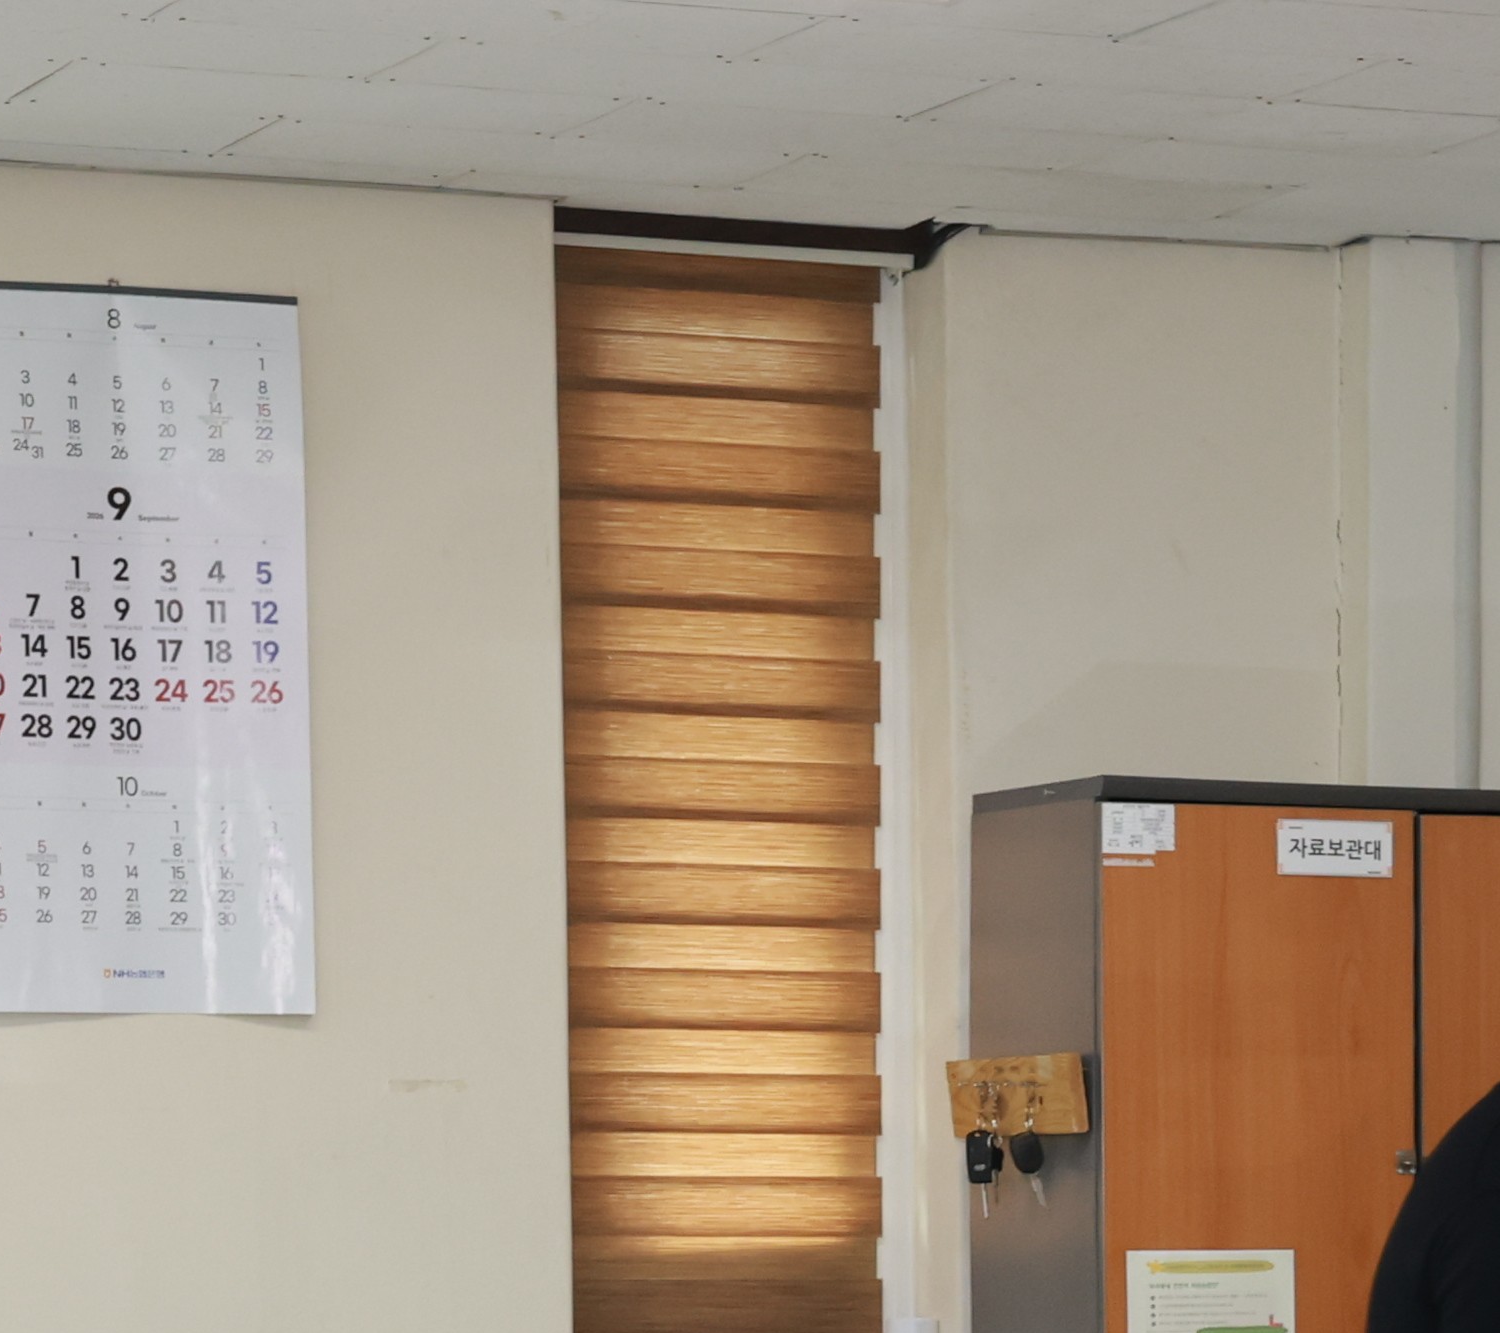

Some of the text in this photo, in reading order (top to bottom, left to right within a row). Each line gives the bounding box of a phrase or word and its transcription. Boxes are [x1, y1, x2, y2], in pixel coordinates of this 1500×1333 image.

[107, 308, 121, 329] 8
[106, 487, 131, 521] 9
[71, 555, 272, 584] 1 2 3 4 5
[25, 593, 40, 616] 7
[70, 595, 85, 619] 8
[114, 597, 129, 621] 9
[154, 599, 183, 623] 10
[205, 599, 225, 623] 11
[251, 600, 278, 624] 12
[20, 633, 47, 657] 14
[66, 635, 91, 659] 15
[110, 637, 136, 661] 16
[157, 639, 182, 662] 17
[204, 639, 231, 663] 18
[252, 640, 279, 662] 19
[22, 673, 46, 697] 21
[65, 675, 95, 699] 22
[109, 676, 140, 701] 23
[154, 678, 187, 702] 24
[202, 679, 234, 702] 25
[251, 679, 283, 704] 26
[20, 713, 52, 738] 28
[66, 715, 96, 739] 29
[110, 716, 141, 741] 30
[116, 776, 139, 797] 10
[1288, 838, 1382, 860] 자료보관대
